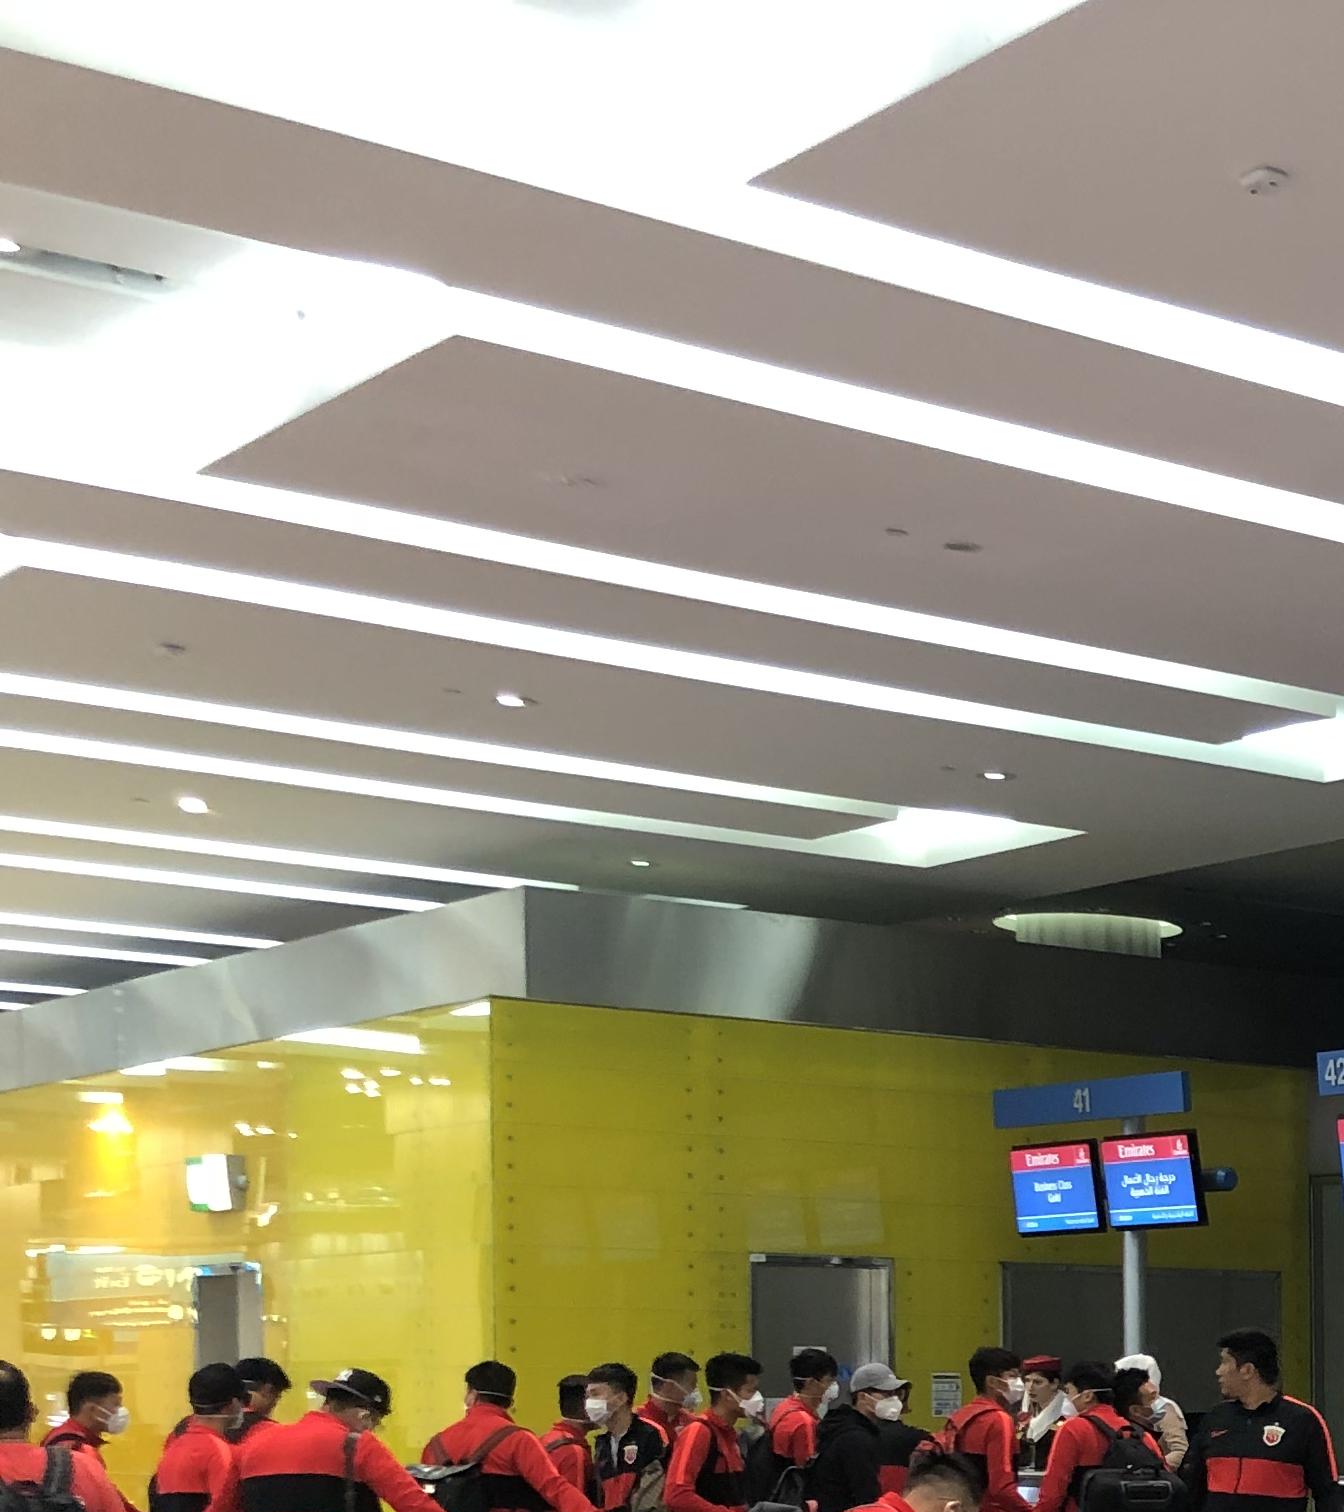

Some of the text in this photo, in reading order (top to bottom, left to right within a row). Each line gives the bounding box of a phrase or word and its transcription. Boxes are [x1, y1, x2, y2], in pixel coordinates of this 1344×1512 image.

[1072, 1087, 1092, 1114] 41
[1117, 1143, 1155, 1158] Emirates
[1025, 1152, 1059, 1167] Emirates
